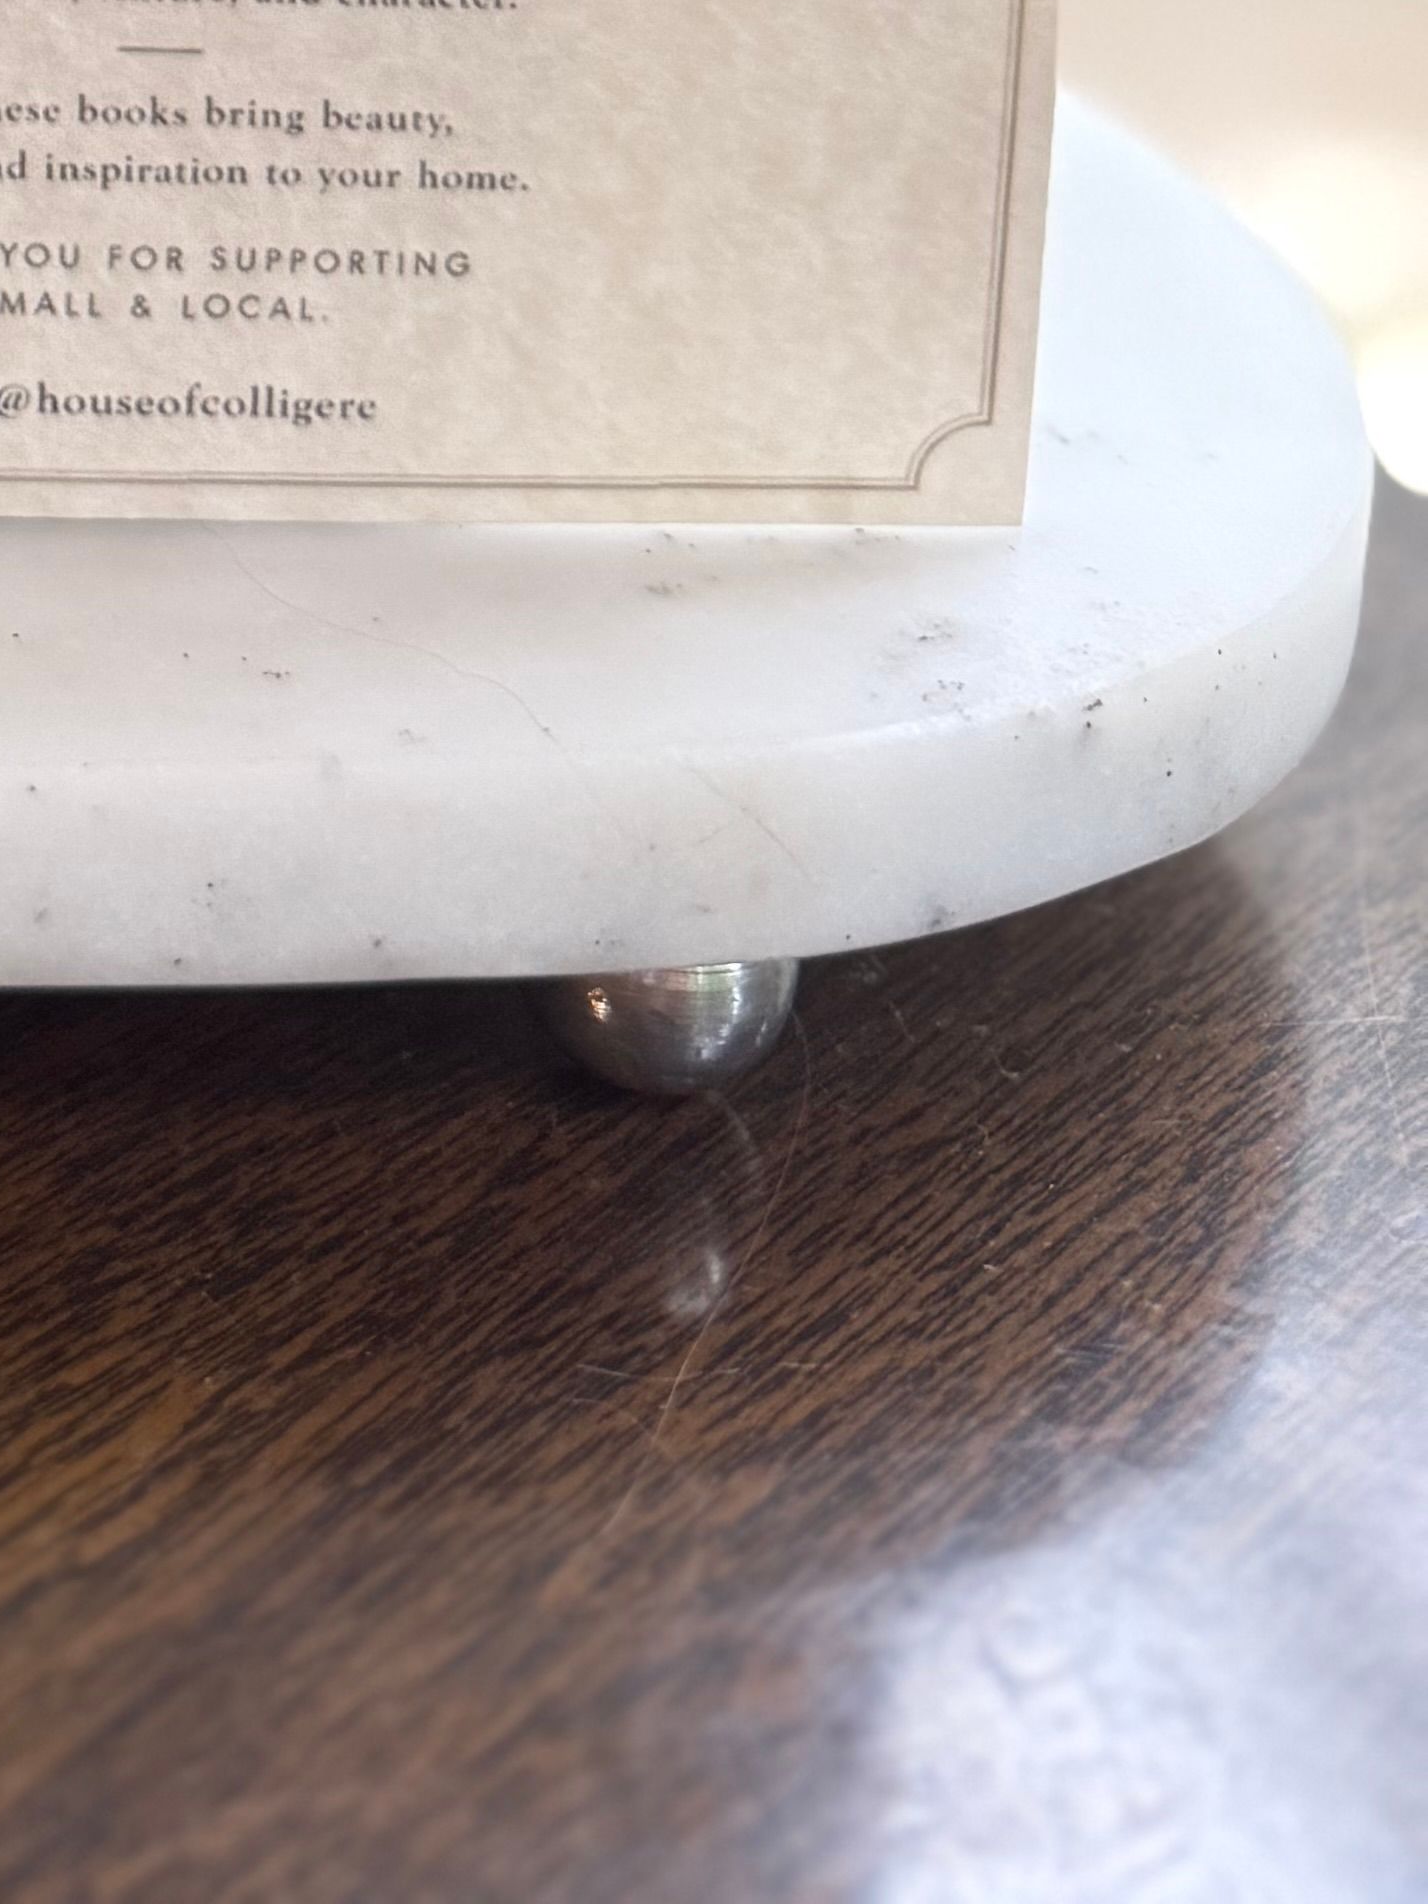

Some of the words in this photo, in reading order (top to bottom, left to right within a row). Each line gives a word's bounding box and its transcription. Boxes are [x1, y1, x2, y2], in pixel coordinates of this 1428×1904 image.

[77, 92, 189, 129] books
[204, 94, 306, 139] bring
[322, 98, 454, 140] beauty,
[45, 152, 249, 192] inspiration
[265, 164, 303, 187] to
[317, 167, 402, 195] your
[418, 159, 529, 193] home.
[107, 244, 185, 275] FOR
[209, 244, 471, 279] SUPPORTING
[129, 293, 153, 320] &
[181, 292, 329, 324] LOCAL.
